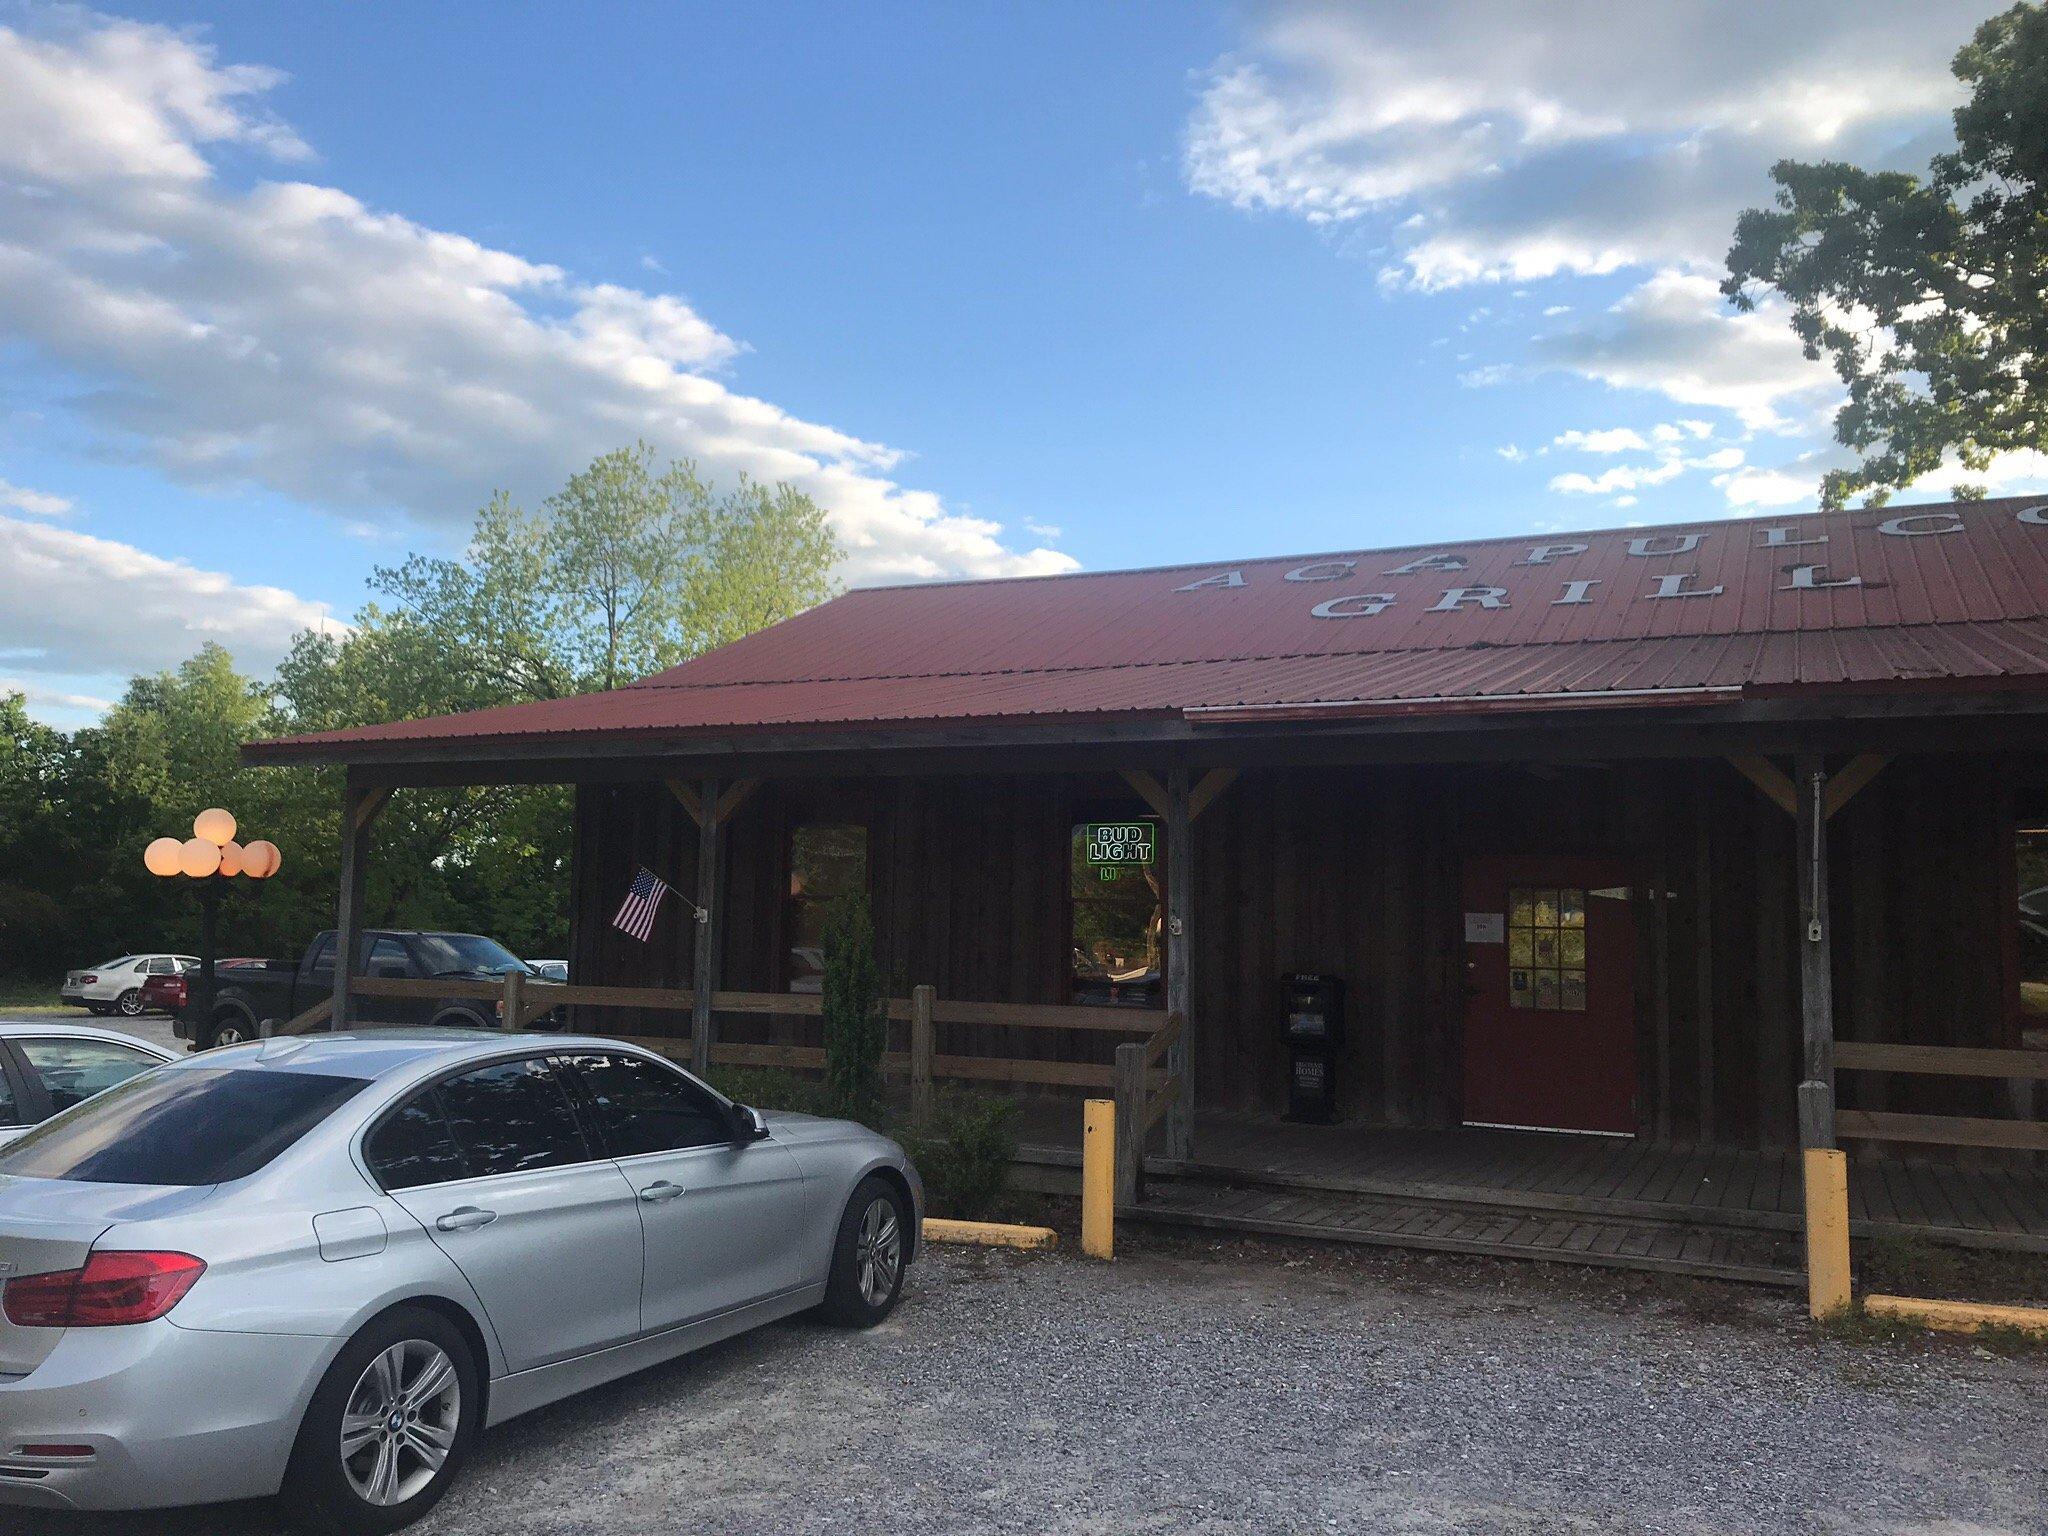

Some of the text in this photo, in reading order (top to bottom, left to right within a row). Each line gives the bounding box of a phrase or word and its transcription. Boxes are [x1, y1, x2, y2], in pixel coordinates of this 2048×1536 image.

[1310, 563, 1862, 619] GRILL
[1098, 827, 1142, 844] BUD
[1089, 843, 1151, 860] LIGHT
